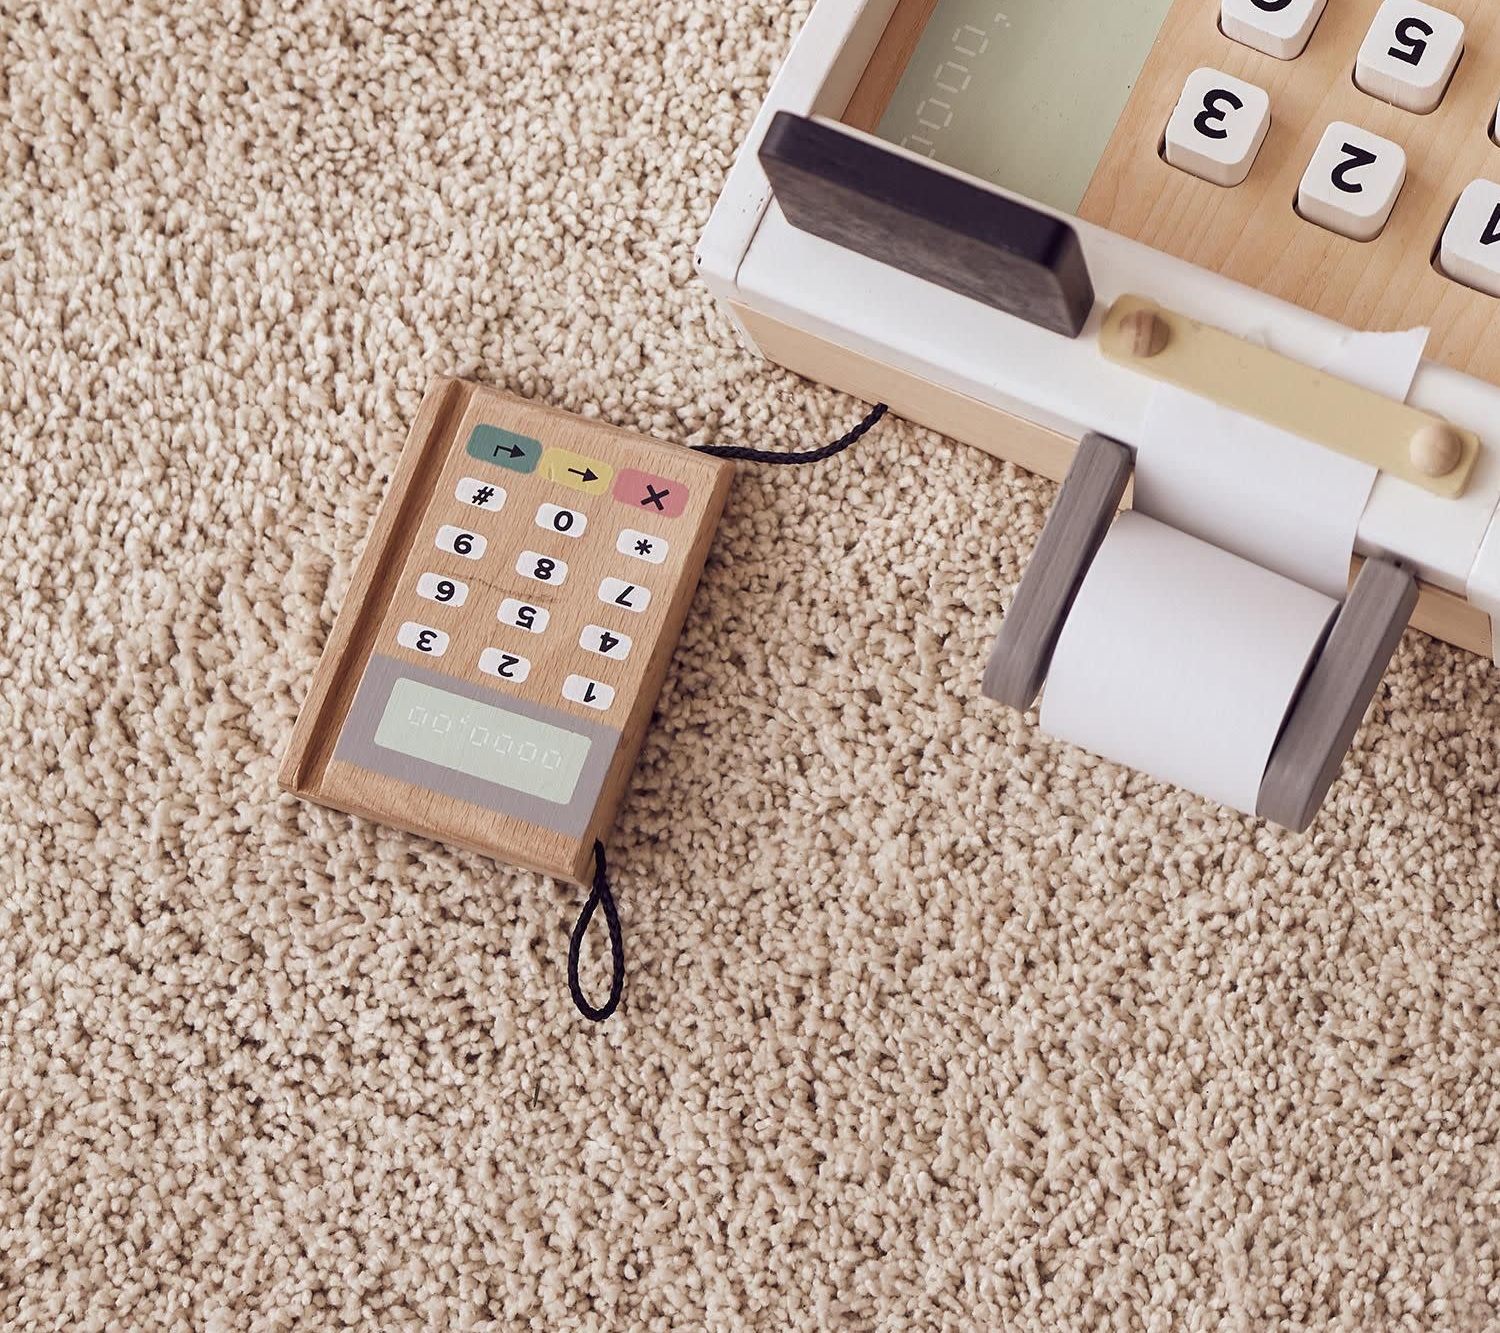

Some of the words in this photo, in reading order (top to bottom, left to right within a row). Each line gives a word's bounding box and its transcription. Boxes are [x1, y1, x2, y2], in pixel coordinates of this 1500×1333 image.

[1388, 18, 1433, 66] 5
[1194, 89, 1243, 139] 3
[1332, 143, 1377, 193] 2
[554, 511, 573, 531] 0
[454, 534, 474, 554] 9
[534, 558, 555, 580] 8
[435, 581, 455, 601] 6
[615, 586, 634, 607] 7
[516, 606, 537, 630] 5
[416, 630, 437, 651] 3
[599, 632, 619, 652] 4
[498, 655, 519, 677] 2
[583, 683, 596, 702] 1
